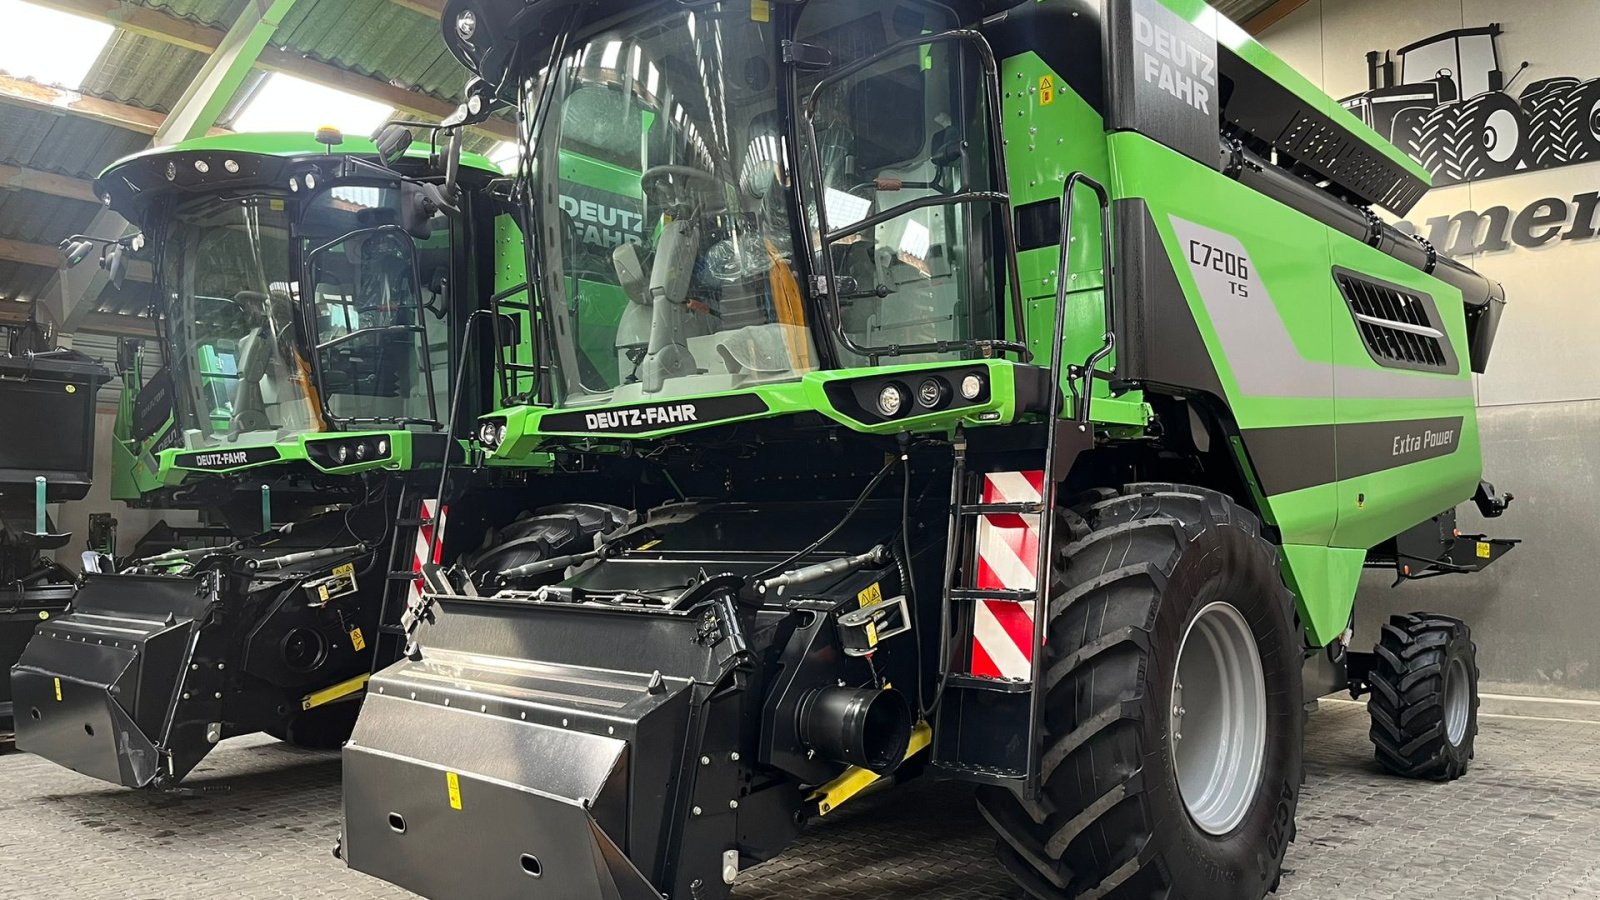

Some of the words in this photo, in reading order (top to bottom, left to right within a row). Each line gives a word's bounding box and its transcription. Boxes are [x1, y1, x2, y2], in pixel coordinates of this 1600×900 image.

[1135, 11, 1215, 86] DEUTZ
[1144, 52, 1209, 116] FAHR
[558, 193, 642, 233] DEUTZ
[1190, 239, 1248, 280] C7206
[1228, 281, 1248, 298] TS
[585, 404, 697, 430] DEUTZ-FAHR
[196, 451, 247, 466] DEUTZ-FAHR
[1392, 434, 1421, 456] Extra
[1423, 430, 1454, 449] Power
